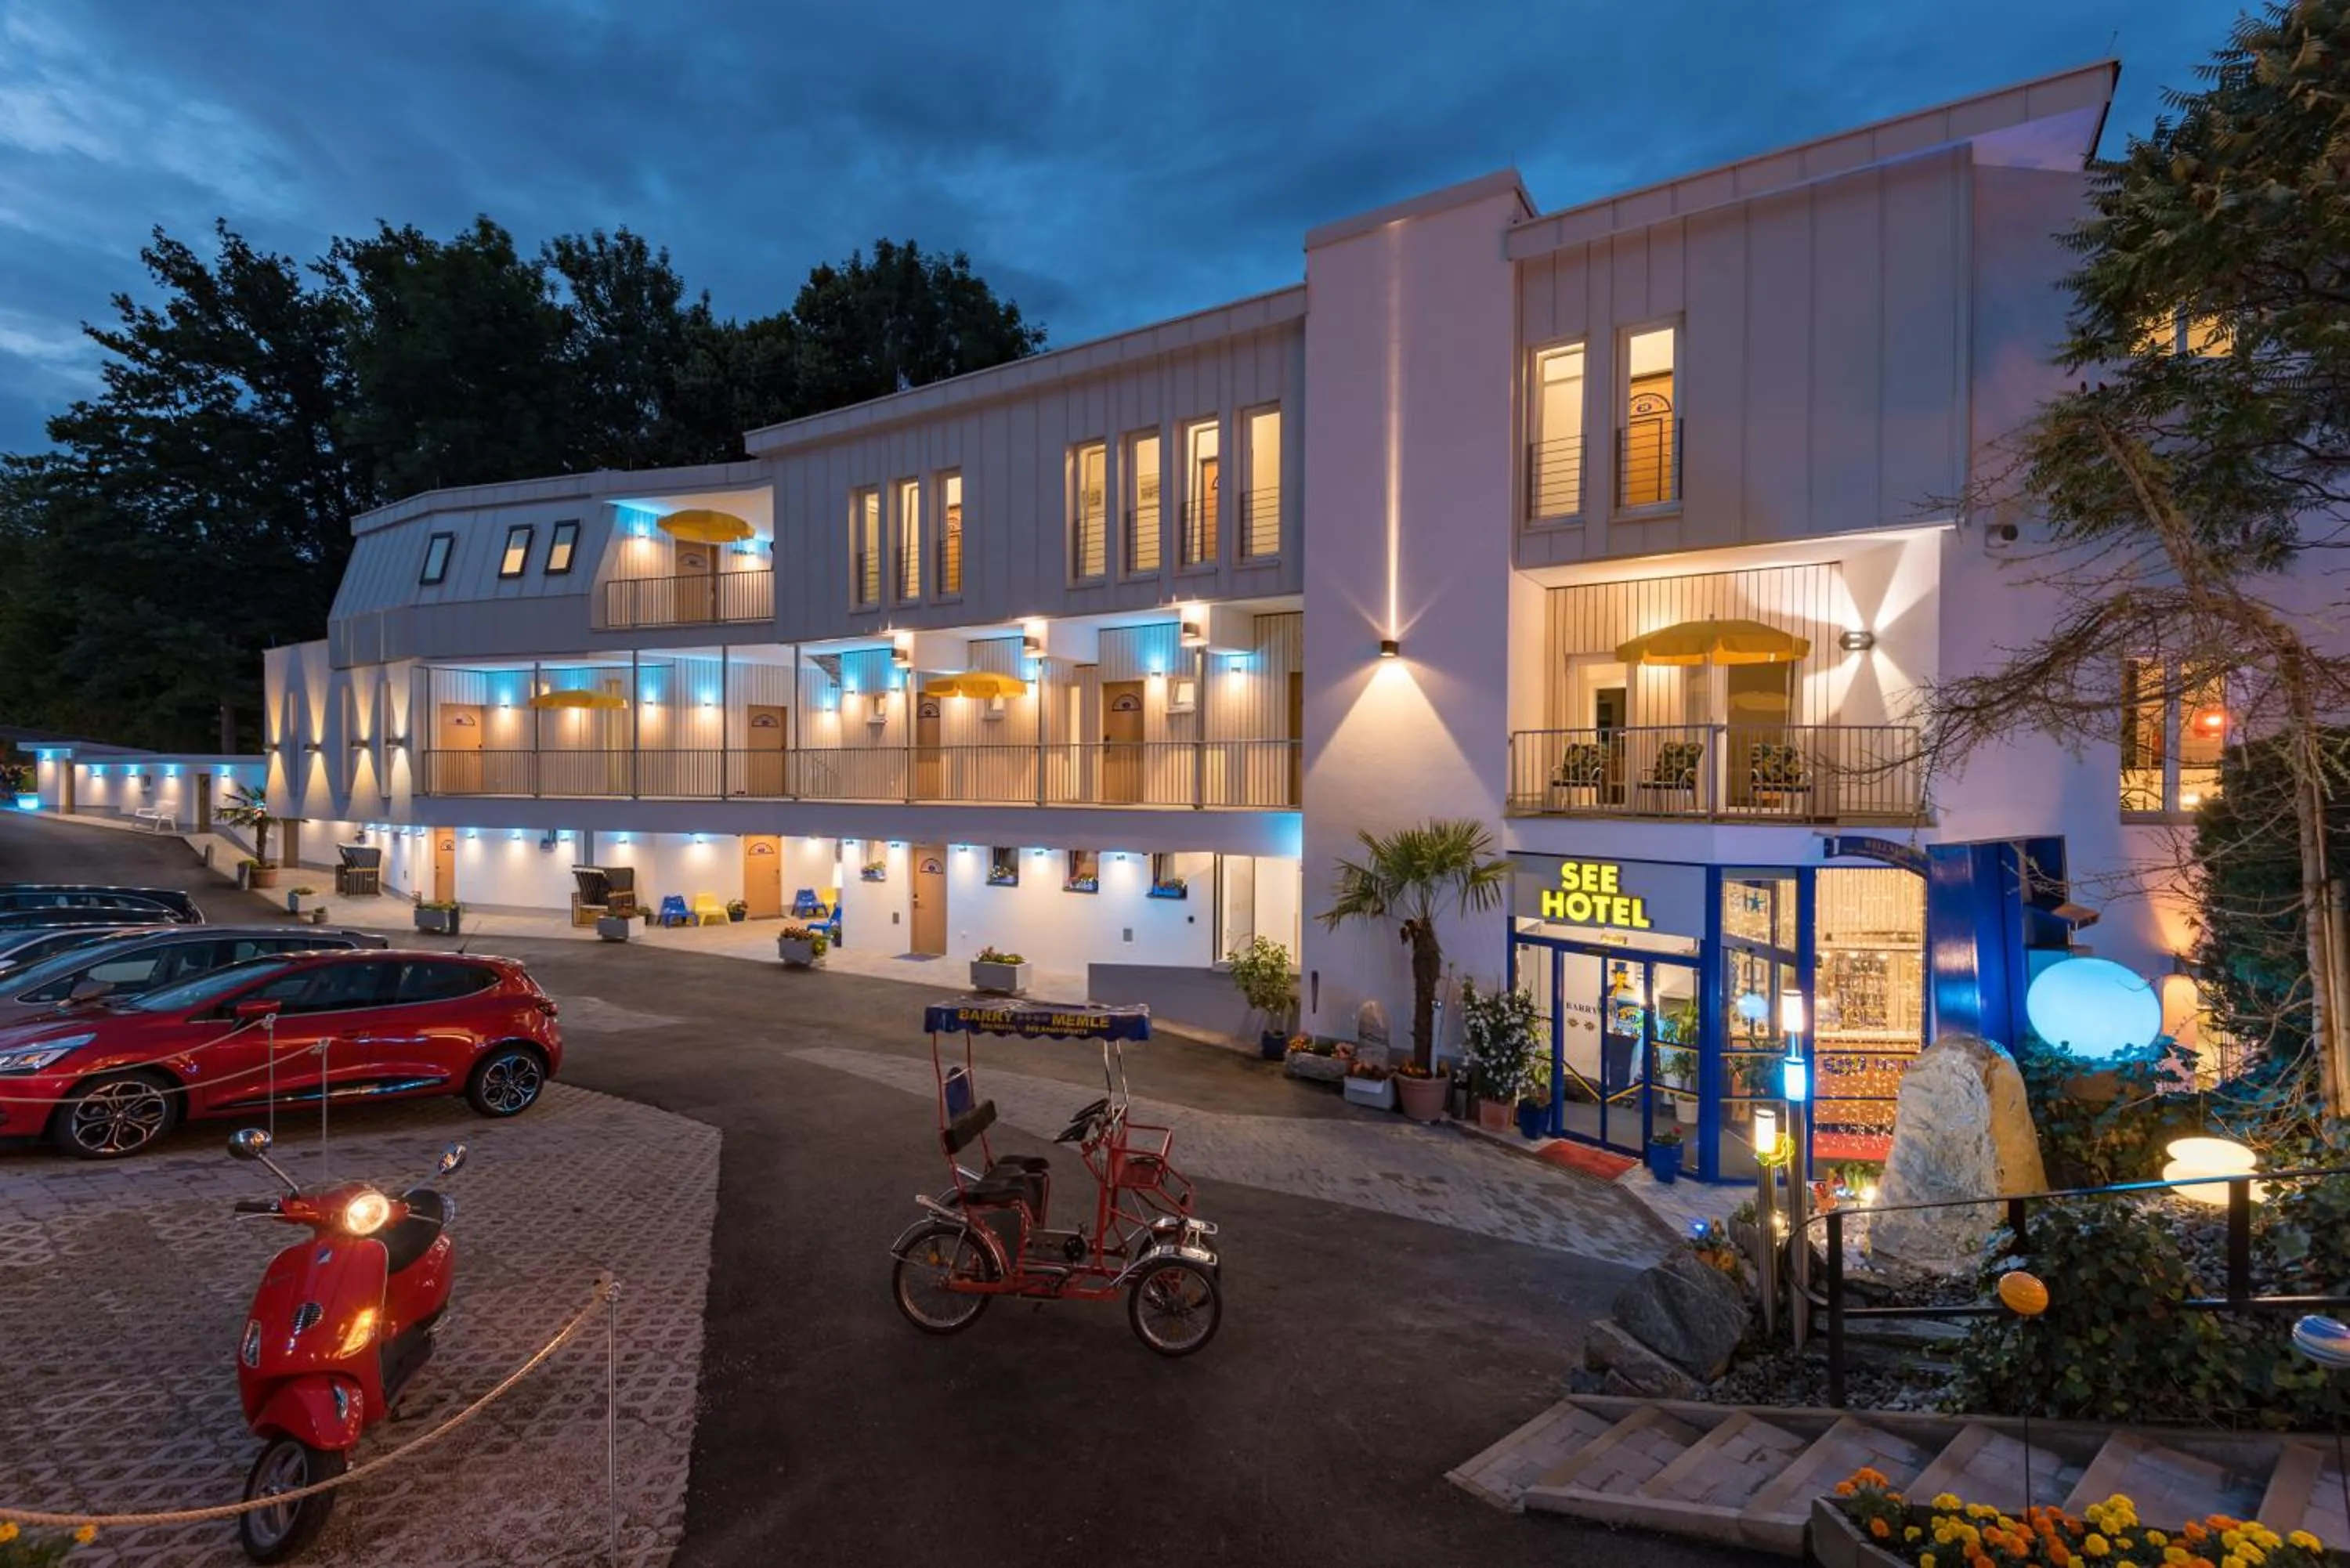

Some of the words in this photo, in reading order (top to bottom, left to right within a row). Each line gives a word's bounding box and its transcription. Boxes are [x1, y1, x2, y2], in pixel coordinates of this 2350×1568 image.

[1561, 862, 1618, 894] SEE
[1542, 891, 1650, 928] HOTEL
[958, 1008, 1014, 1023] BARRY
[1052, 1014, 1111, 1028] MEMLE
